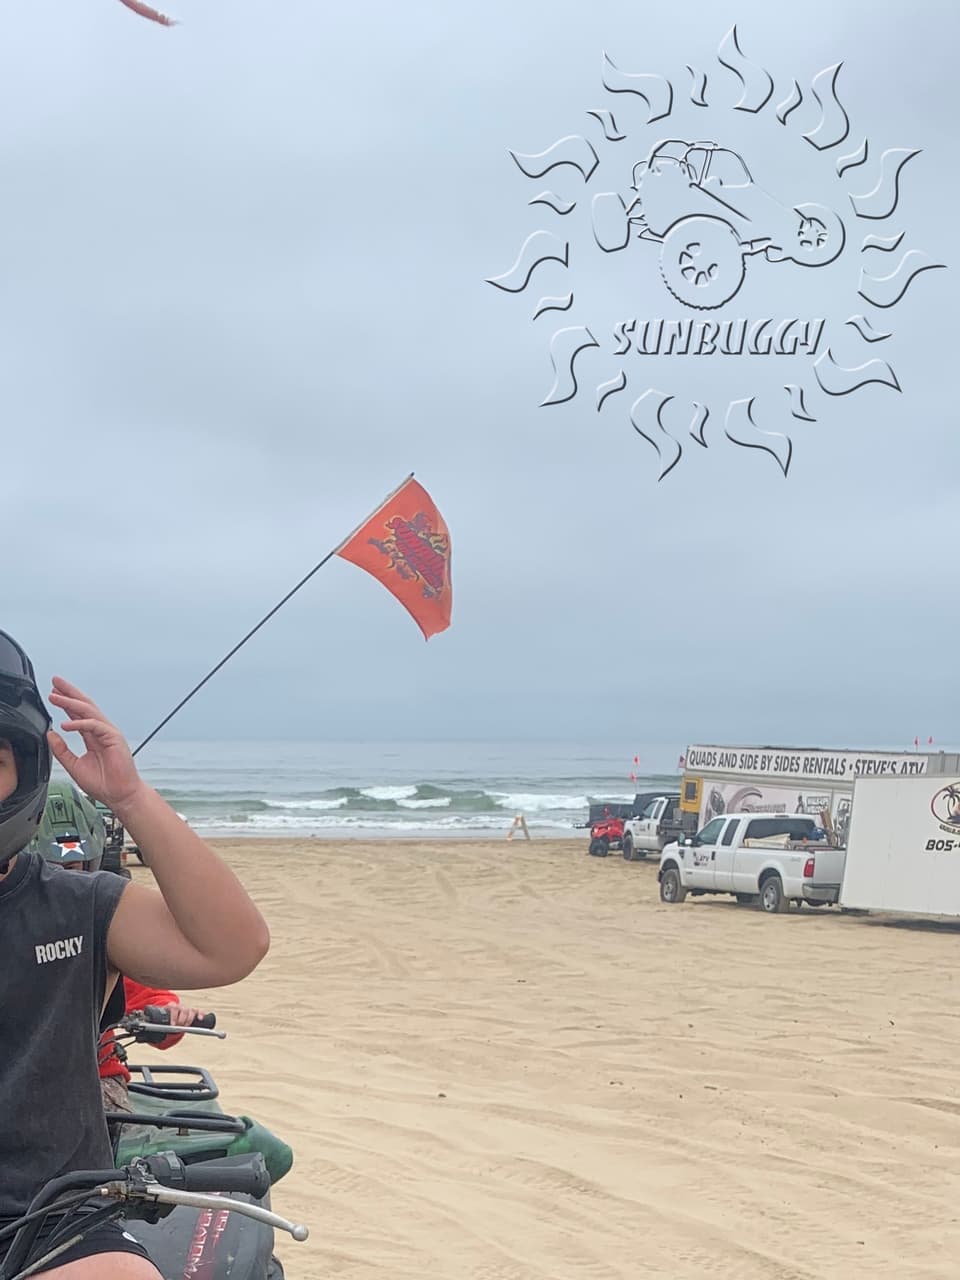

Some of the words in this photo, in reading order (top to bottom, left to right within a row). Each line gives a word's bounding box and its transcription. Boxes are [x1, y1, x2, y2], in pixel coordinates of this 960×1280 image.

[689, 750, 717, 767] QUADS
[719, 752, 738, 769] AND
[739, 753, 759, 771] SIDE
[760, 754, 774, 772] BY
[774, 755, 801, 773] SIDES
[802, 756, 846, 776] RENTALS
[854, 759, 897, 775] STEVE'S
[900, 761, 925, 775] ATV
[35, 935, 83, 964] ROCKY
